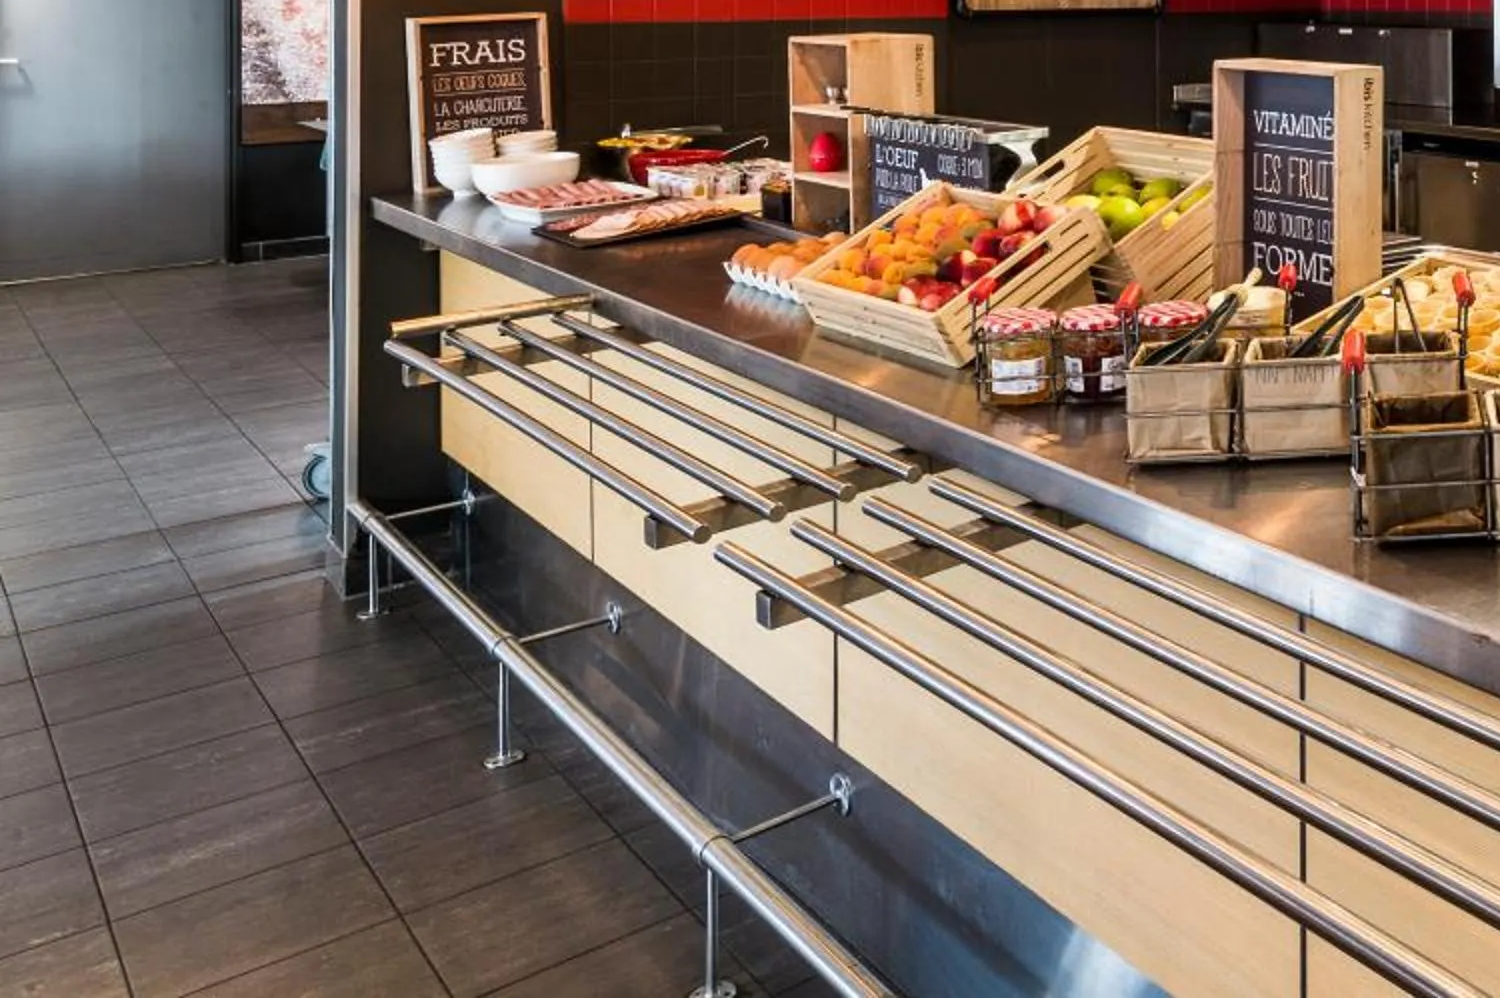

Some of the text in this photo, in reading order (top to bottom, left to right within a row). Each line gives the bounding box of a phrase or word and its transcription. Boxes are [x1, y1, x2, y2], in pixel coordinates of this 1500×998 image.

[429, 38, 526, 67] FRAIS
[434, 100, 451, 117] LA
[435, 113, 529, 133] LES PRODUITS
[1253, 152, 1281, 195] LES
